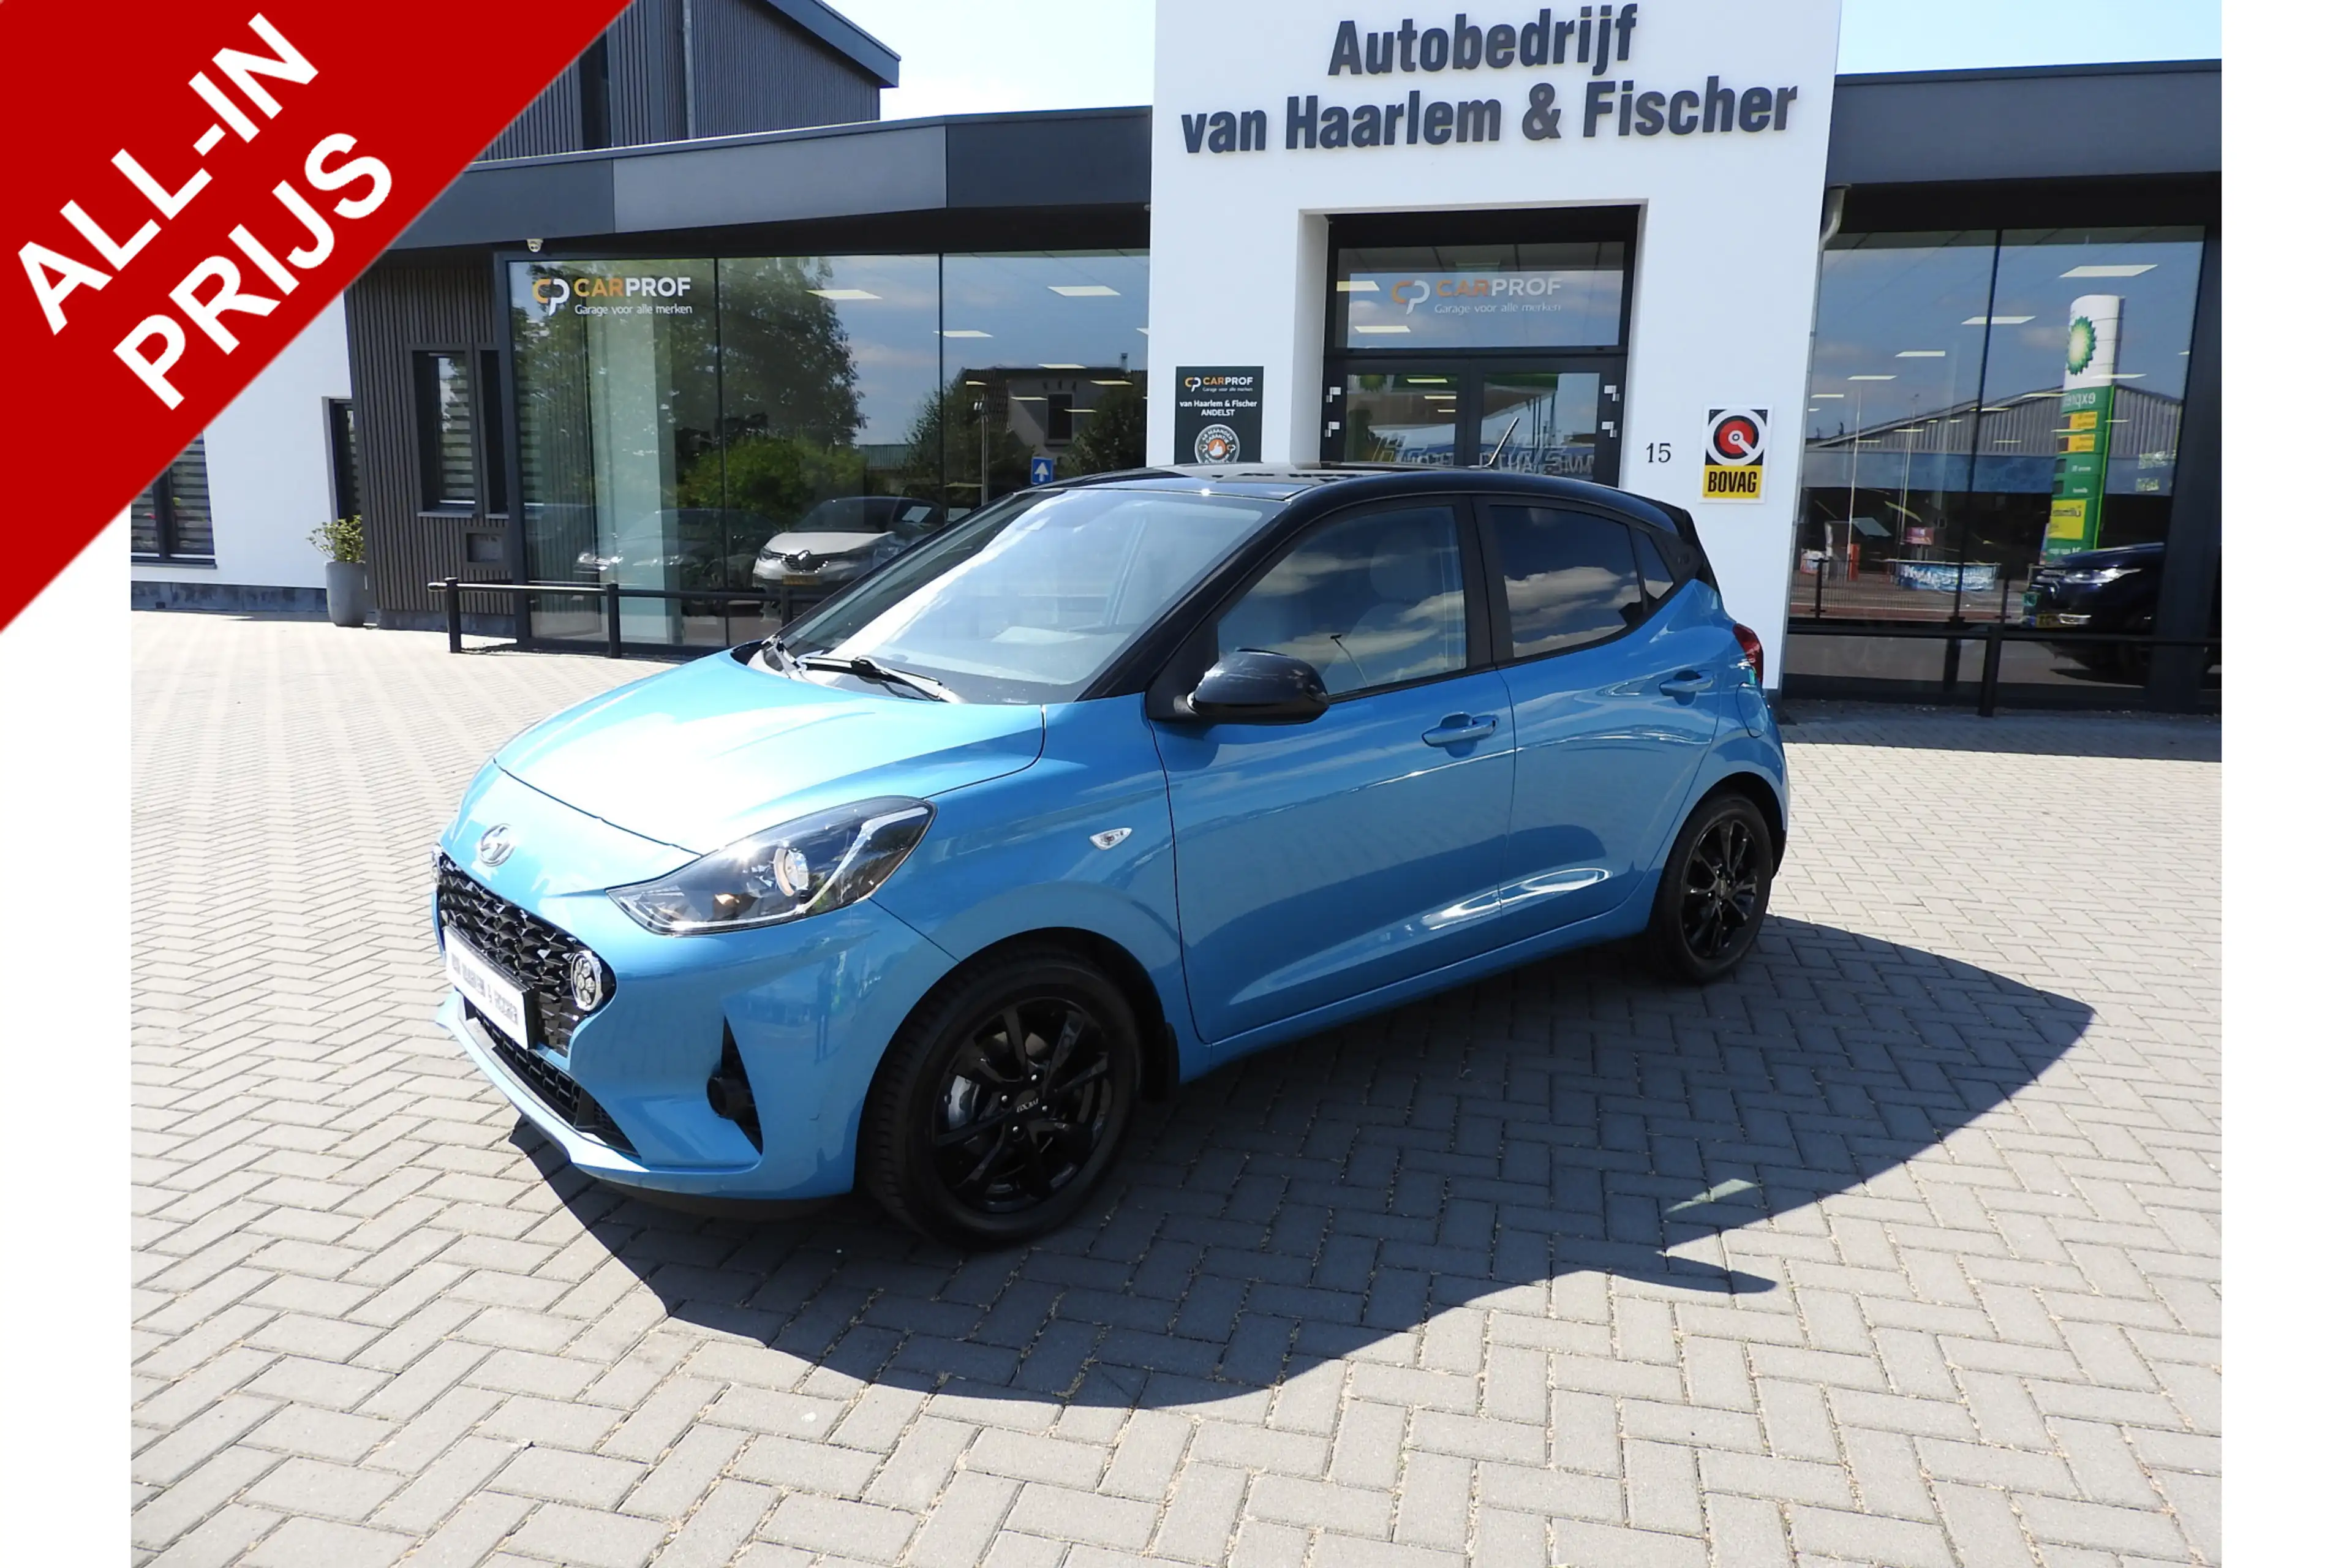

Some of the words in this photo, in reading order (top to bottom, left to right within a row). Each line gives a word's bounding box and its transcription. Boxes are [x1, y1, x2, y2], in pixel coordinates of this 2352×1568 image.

[1327, 3, 1638, 76] Autobedrijf
[1182, 109, 1267, 153] van
[1286, 90, 1501, 150] Haarlem
[1521, 82, 1561, 141] &
[1583, 75, 1798, 138] Fischer
[574, 277, 692, 297] CARPROF
[1436, 277, 1562, 297] CARPROF
[575, 304, 608, 317] Garage
[636, 304, 653, 314] alle
[655, 303, 693, 314] merken
[1434, 304, 1471, 316] Garage
[1474, 305, 1498, 314] voor
[1501, 303, 1518, 313] alle
[1203, 377, 1253, 385] CARPROF
[1646, 442, 1672, 463] 15
[1708, 470, 1757, 492] BOVAG
